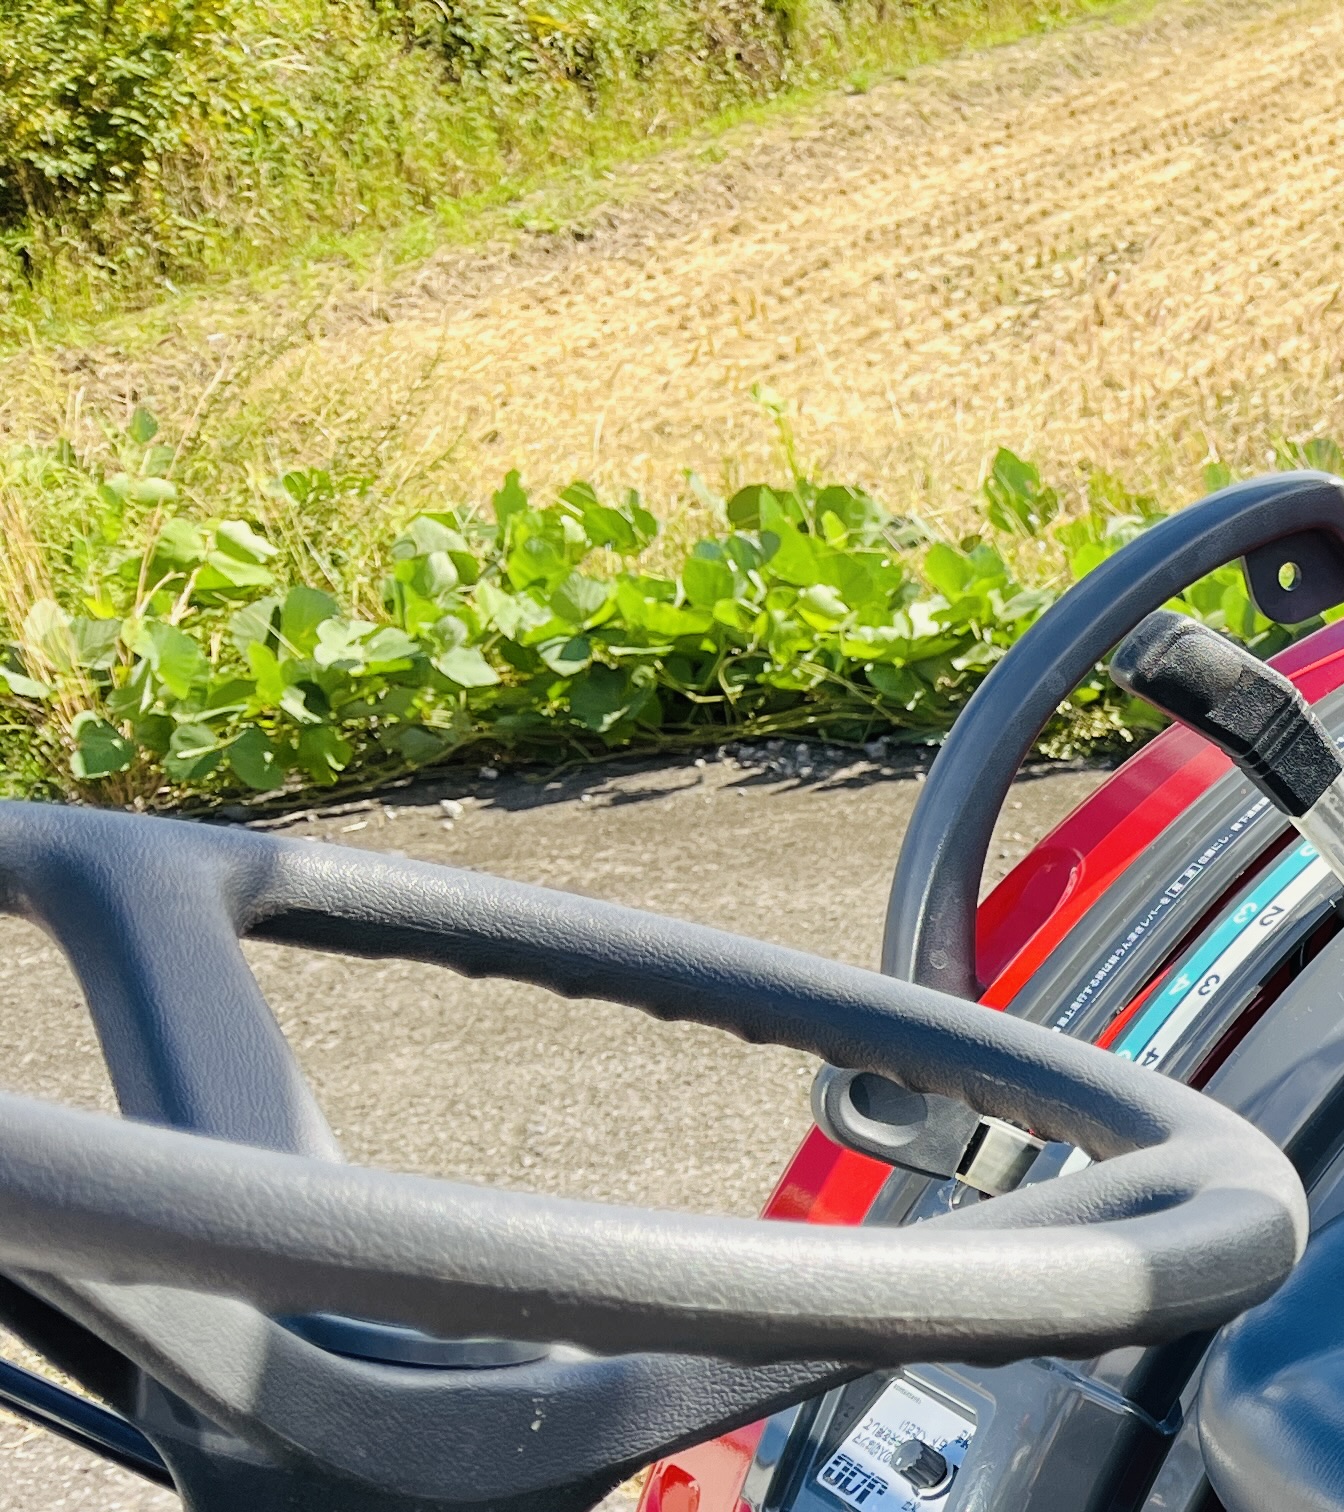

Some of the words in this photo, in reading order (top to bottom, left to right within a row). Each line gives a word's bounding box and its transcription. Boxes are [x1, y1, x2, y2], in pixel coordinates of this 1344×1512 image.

[1232, 901, 1257, 924] 3
[1258, 905, 1284, 928] 2
[1168, 974, 1190, 995] 4
[1197, 974, 1221, 995] 3
